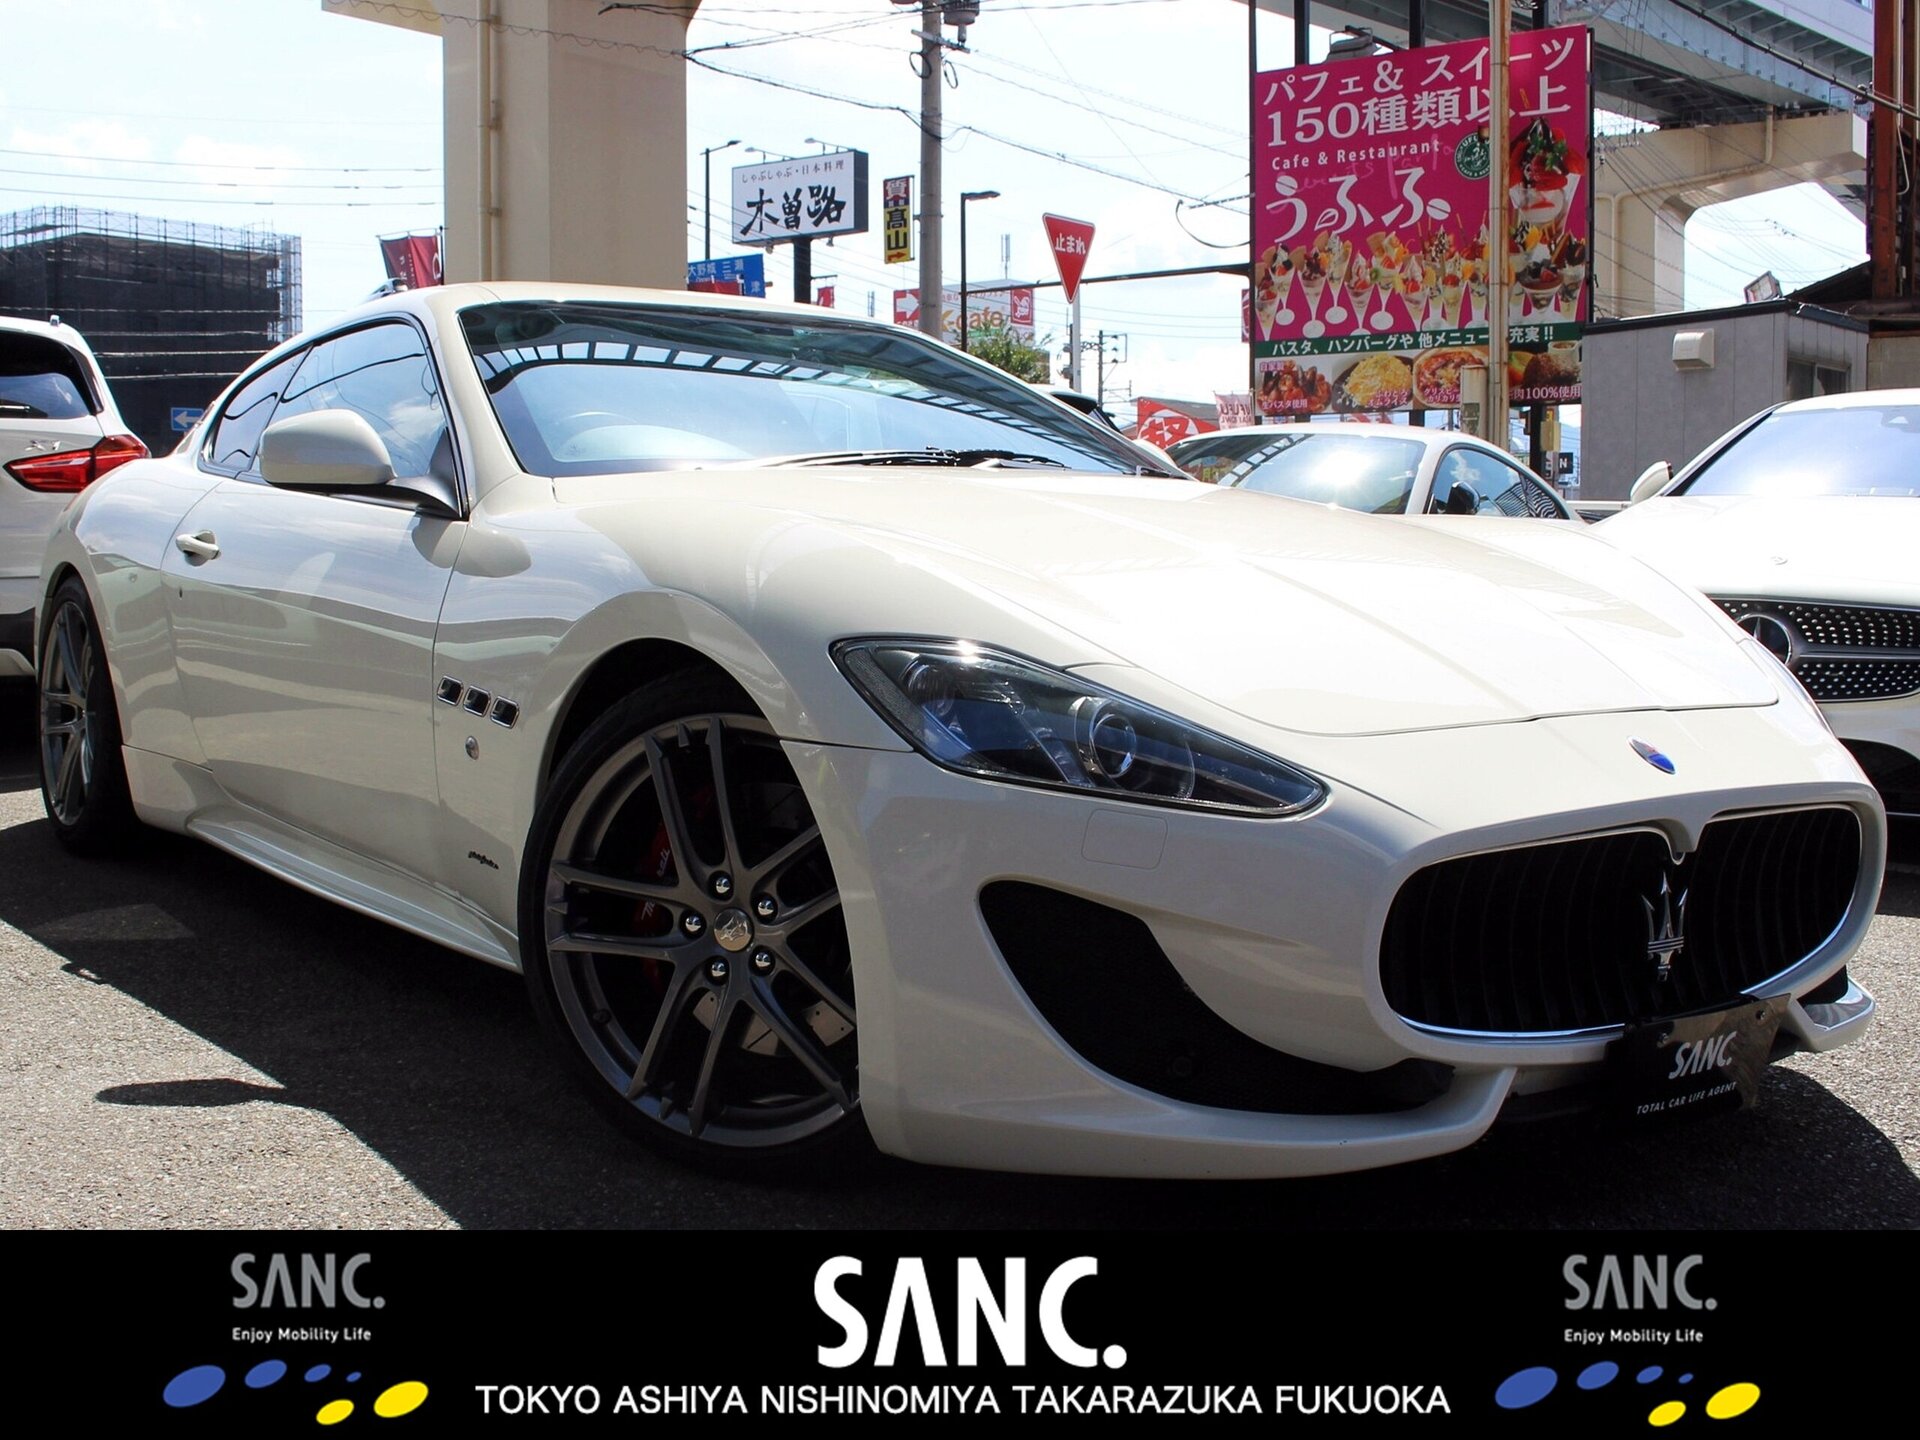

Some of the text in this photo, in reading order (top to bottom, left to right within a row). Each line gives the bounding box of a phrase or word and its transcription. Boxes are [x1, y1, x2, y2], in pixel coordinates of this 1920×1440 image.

[1420, 37, 1575, 86] スイーツ
[1267, 74, 1572, 147] 150種類以上
[1272, 155, 1310, 170] Cafe
[1318, 151, 1329, 165] &
[1337, 138, 1440, 163] Restaurant
[740, 184, 846, 236] 木曽路
[1265, 166, 1451, 245] うふふ
[1055, 232, 1086, 255] 止まれ
[1668, 1031, 1737, 1080] SANC.
[1637, 1081, 1737, 1115] TOTAL CAR LIFE AGENT
